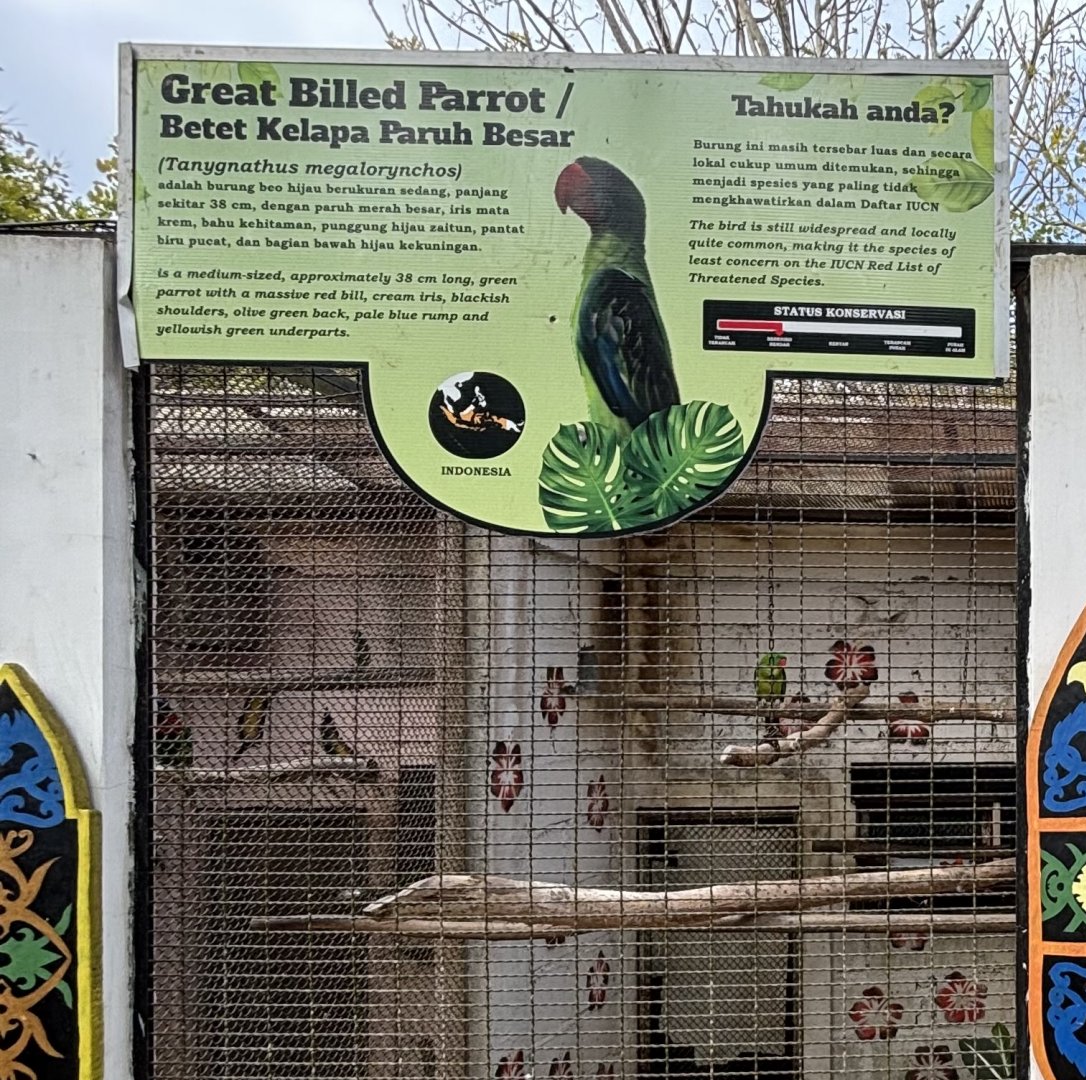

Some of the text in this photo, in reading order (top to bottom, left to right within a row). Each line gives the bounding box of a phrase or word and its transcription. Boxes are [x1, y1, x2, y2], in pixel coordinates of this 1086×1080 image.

[160, 73, 574, 119] Great Billed Parrot /
[730, 94, 956, 124] Tahukah anda?
[159, 113, 575, 148] Betet Kelapa Paruh Besar
[157, 156, 299, 176] (Tanygnathus
[815, 197, 856, 209] dalam
[860, 198, 902, 211] Daftar
[905, 200, 940, 212] IUCN
[688, 219, 957, 241] The bird is still widespread and locally
[156, 234, 482, 254] biru pucat, dan bagian bawah hijau kekuningan.
[688, 254, 942, 276] least concern on the IUCN Red List of
[157, 267, 518, 287] is a medium-sized, approximately 38 cm long, green
[688, 272, 825, 288] Threatened Species.
[154, 287, 510, 304] parrot with a massive red bill, cream iris, blackish
[155, 304, 489, 324] shoulders, olive green back, pale blue rump and
[773, 305, 906, 320] STATUS KONSERVASI
[155, 323, 350, 339] yellowish green underparts.
[440, 465, 512, 477] INDONESIA
